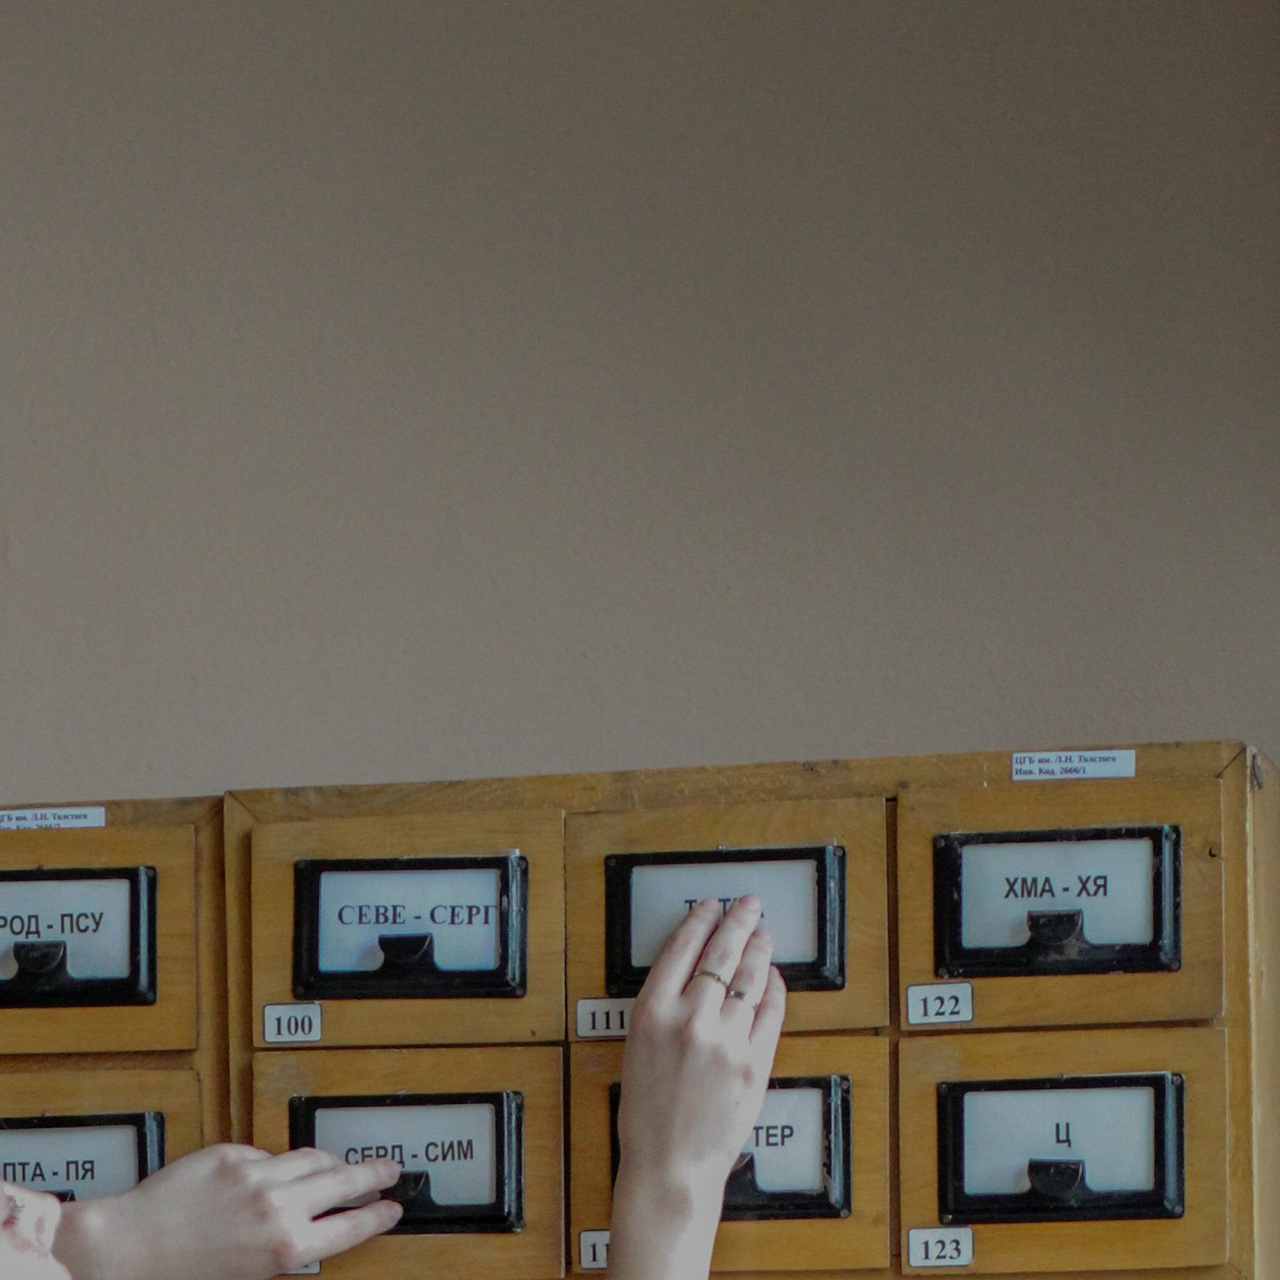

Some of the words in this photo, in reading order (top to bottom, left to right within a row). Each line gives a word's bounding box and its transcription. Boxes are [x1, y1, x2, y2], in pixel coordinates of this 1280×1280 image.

[1005, 877, 1055, 898] ХМА
[1077, 876, 1107, 897] ХЯ
[61, 913, 103, 933] ПСУ
[338, 905, 405, 924] СЕВЕ
[923, 995, 960, 1016] 122
[276, 1017, 312, 1035] 100
[1056, 1123, 1071, 1147] Ц
[3, 1162, 45, 1182] ПТА
[66, 1160, 94, 1180] ПЯ
[920, 1239, 961, 1260] 123
